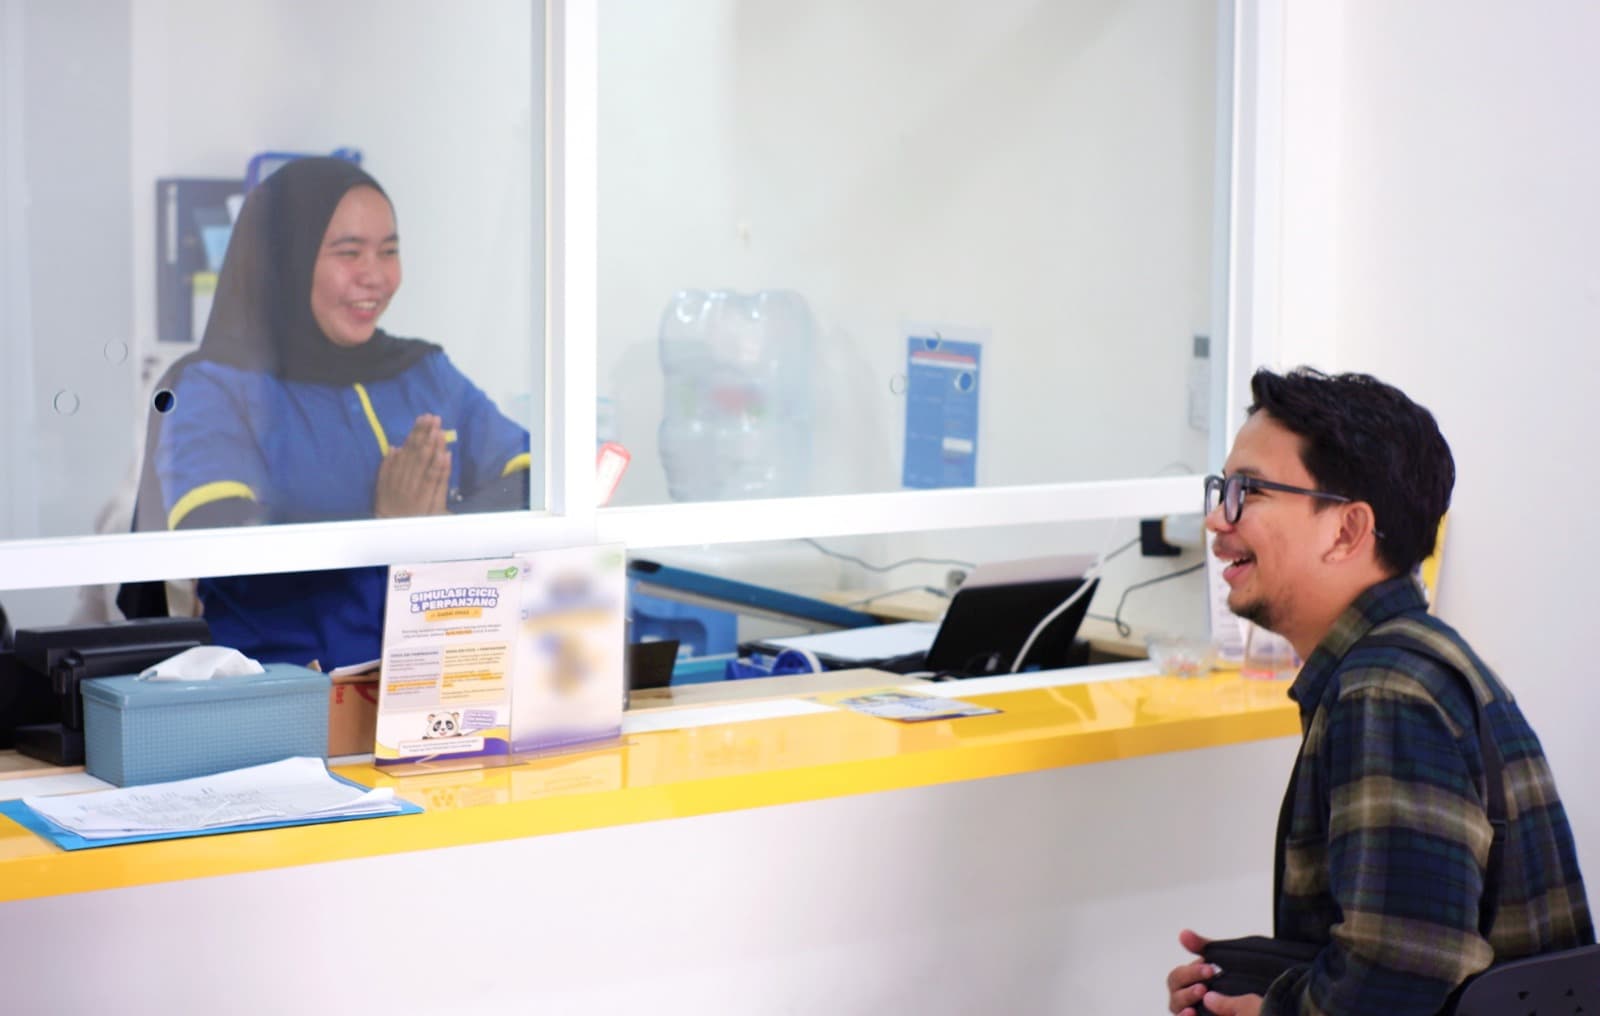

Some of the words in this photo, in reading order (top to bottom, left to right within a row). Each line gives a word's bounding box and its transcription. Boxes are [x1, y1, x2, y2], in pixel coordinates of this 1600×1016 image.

[411, 589, 467, 602] SIMULASI
[468, 587, 498, 598] CICIL
[411, 602, 420, 612] &
[421, 598, 497, 611] PERPANJANG
